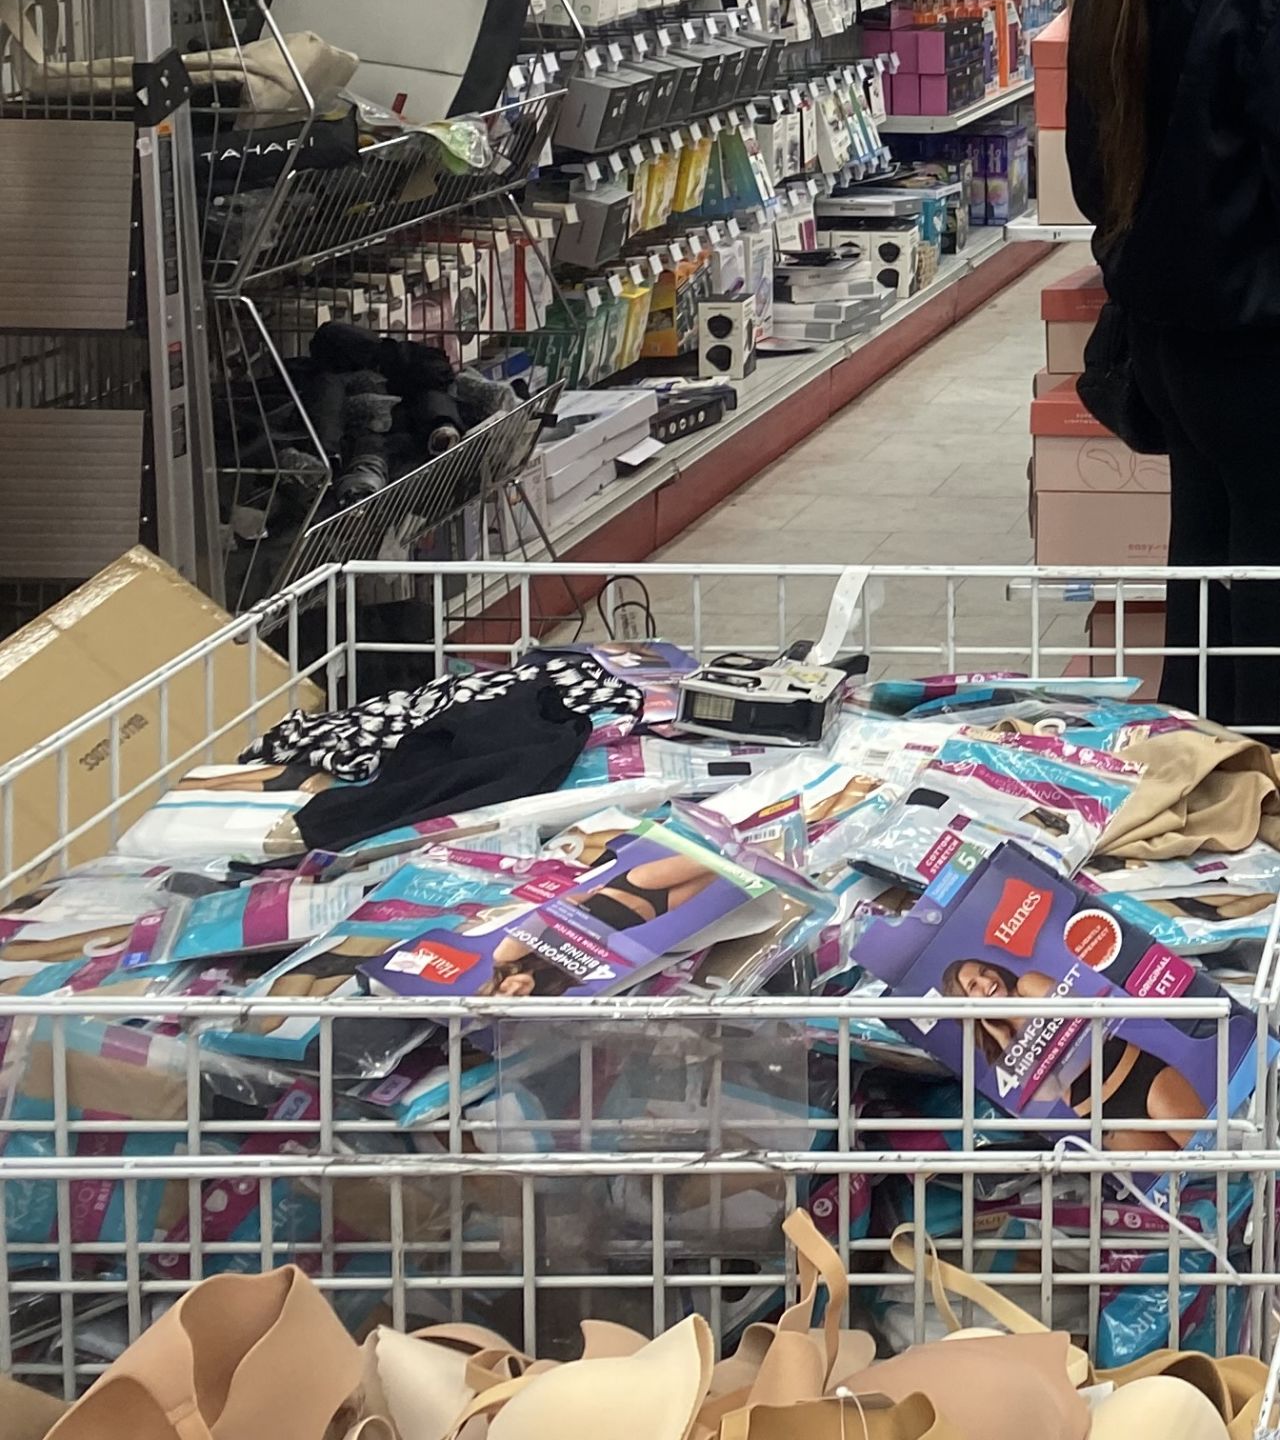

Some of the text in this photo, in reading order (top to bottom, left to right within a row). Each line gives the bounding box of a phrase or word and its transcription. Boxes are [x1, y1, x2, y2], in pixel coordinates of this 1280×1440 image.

[925, 834, 952, 867] COTTON
[929, 839, 959, 875] STRETCH
[960, 850, 976, 870] 5
[539, 879, 560, 890] FIT
[993, 890, 1041, 944] Hanes
[503, 925, 587, 976] COMFORTSOFT
[560, 942, 603, 970] BIKINIS
[582, 963, 617, 981] 4
[1138, 955, 1172, 998] ORIGINAL
[1156, 969, 1175, 996] FIT
[1015, 1017, 1065, 1076] HIPSTERS
[1033, 1047, 1060, 1081] COTTON
[1058, 1017, 1083, 1047] STRETC
[996, 1065, 1020, 1098] 4
